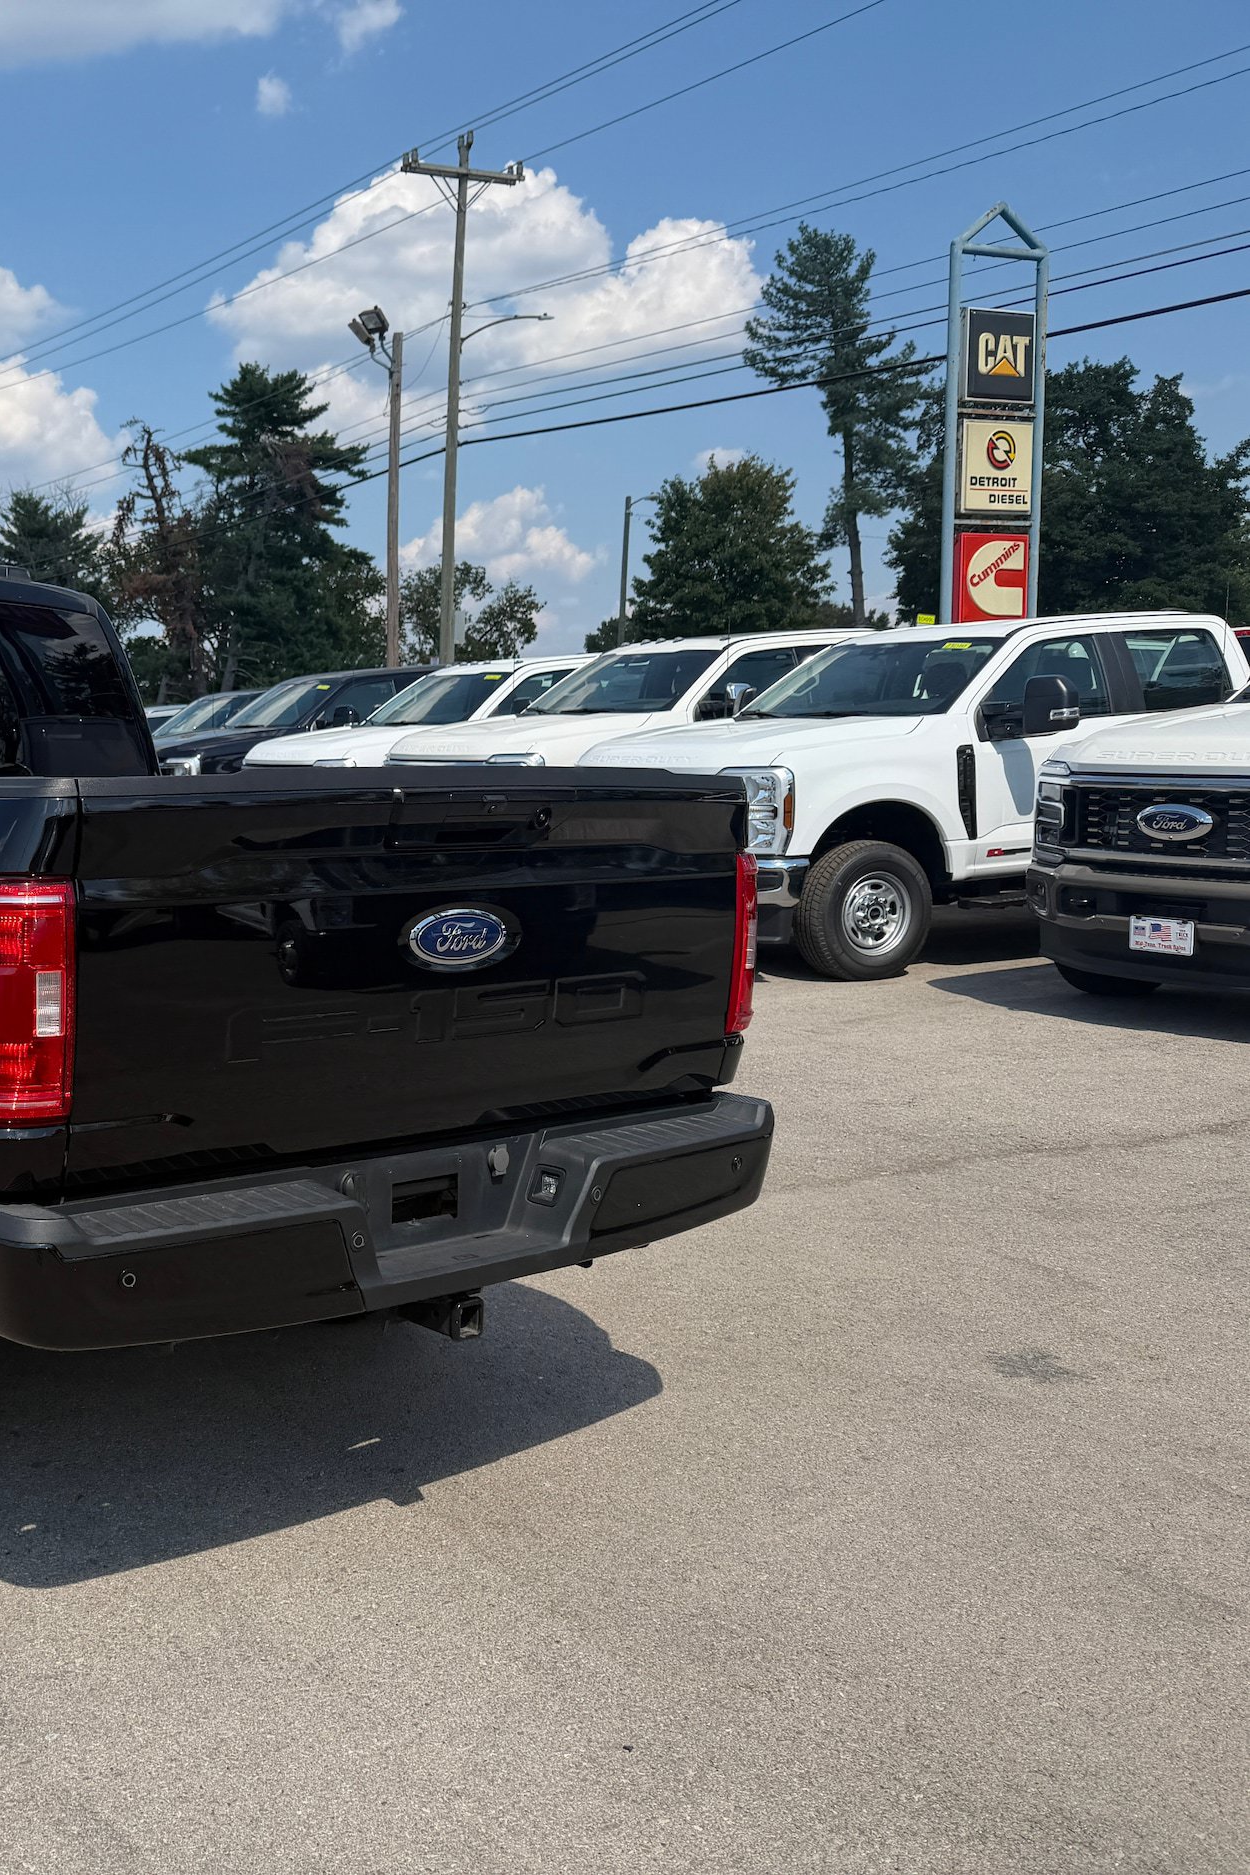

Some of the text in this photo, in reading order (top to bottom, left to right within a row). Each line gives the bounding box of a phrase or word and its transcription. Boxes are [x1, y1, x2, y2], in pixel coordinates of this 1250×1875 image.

[978, 332, 1031, 378] CAT
[970, 476, 1017, 488] DETROIT
[989, 494, 1028, 505] DIESEL
[969, 542, 1021, 588] Cummins
[1096, 750, 1250, 762] SUPER DU
[1152, 813, 1187, 830] Ford
[436, 921, 488, 953] Ford
[226, 972, 645, 1063] F-150
